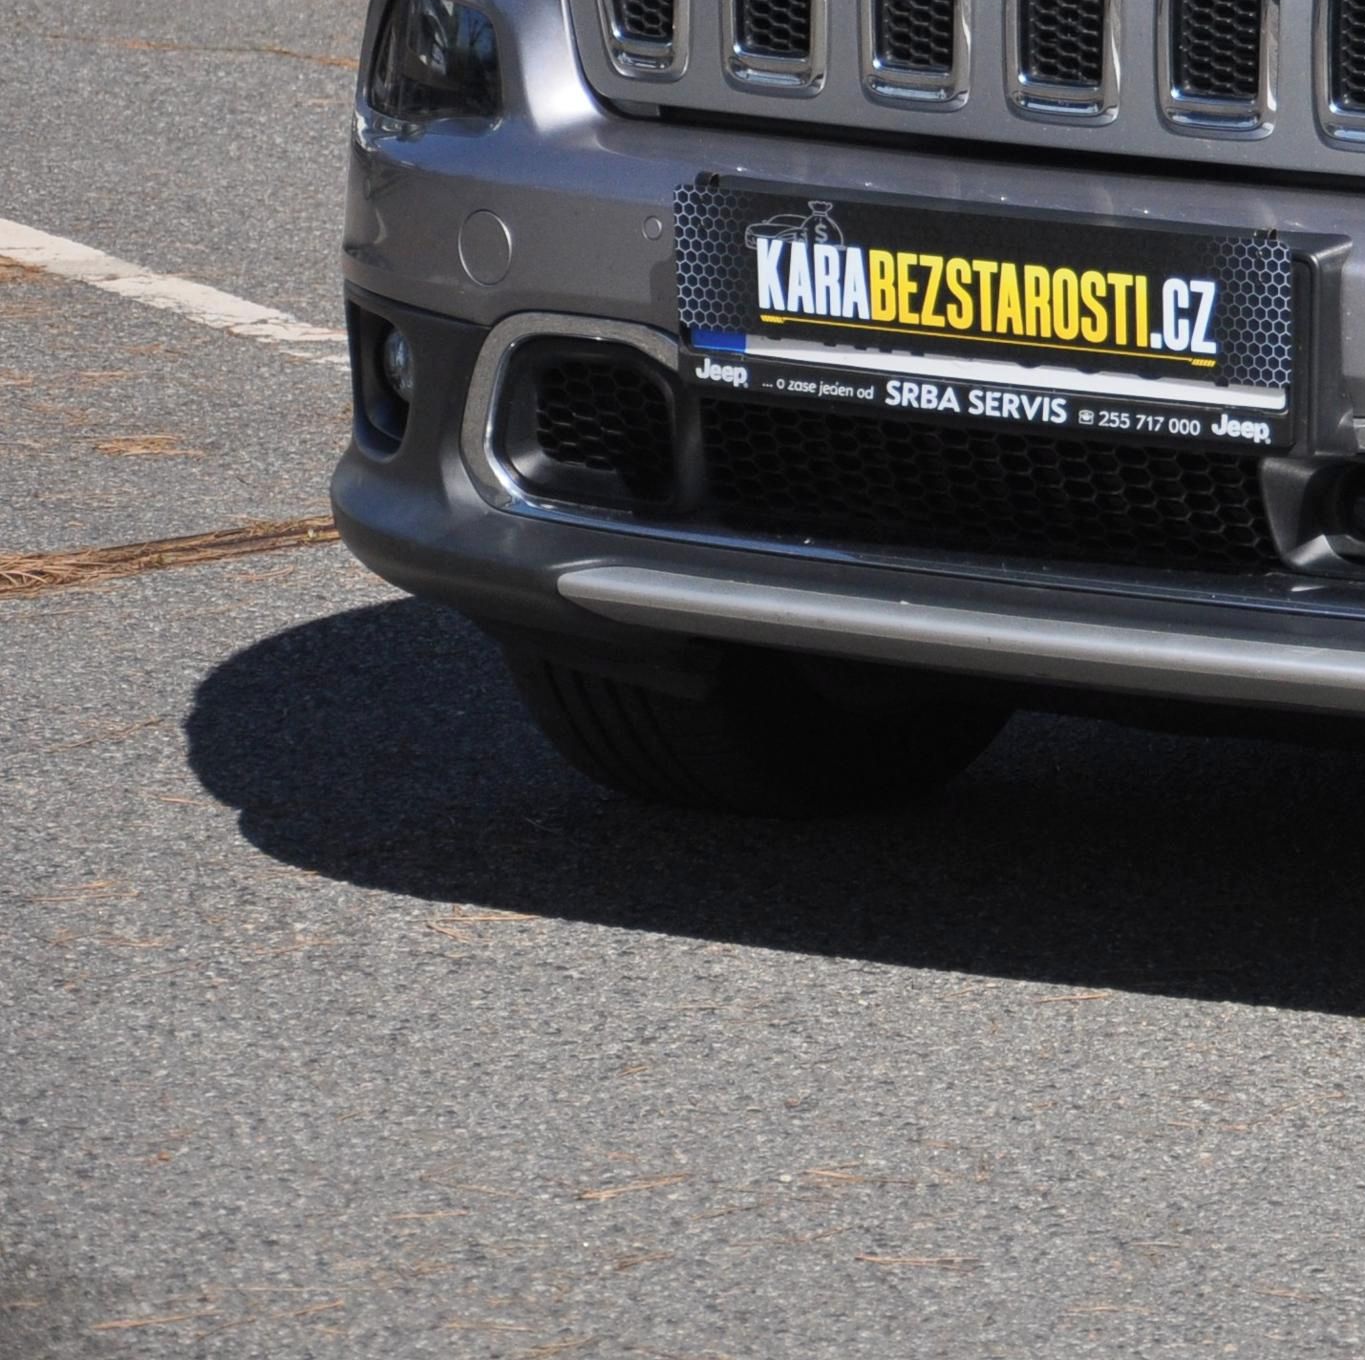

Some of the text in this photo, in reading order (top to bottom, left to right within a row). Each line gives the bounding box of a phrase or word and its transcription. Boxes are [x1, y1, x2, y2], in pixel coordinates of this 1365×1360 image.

[756, 237, 1217, 354] KARABEZSTAROSTI.CZ
[787, 380, 817, 393] zase
[818, 381, 853, 398] jeden
[856, 386, 874, 400] od
[885, 380, 960, 413] SRBA
[968, 389, 1068, 424] SERVIS
[1098, 411, 1131, 429] 255
[1135, 414, 1163, 432] 717
[1168, 418, 1201, 436] 000
